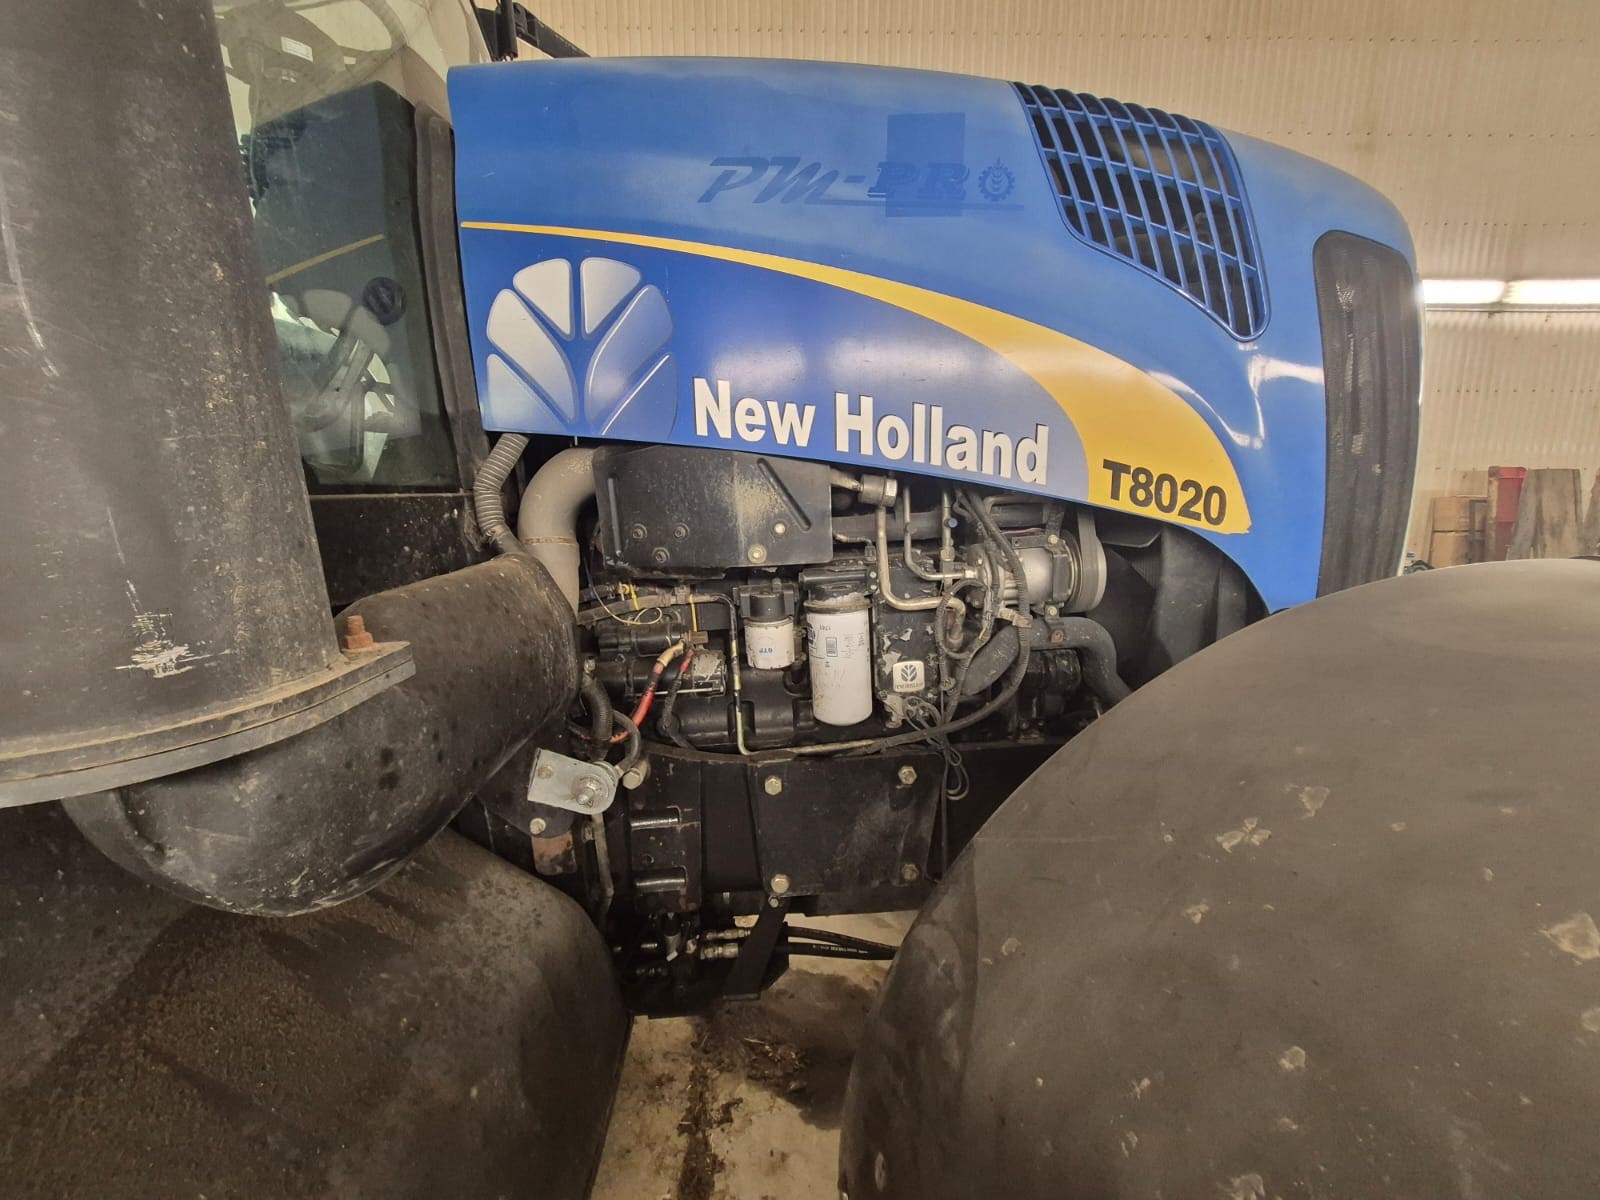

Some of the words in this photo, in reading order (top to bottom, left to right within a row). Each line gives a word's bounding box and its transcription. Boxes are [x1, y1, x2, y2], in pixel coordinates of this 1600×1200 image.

[692, 376, 816, 447] New
[834, 391, 1049, 485] Holland
[1103, 458, 1227, 526] T8020
